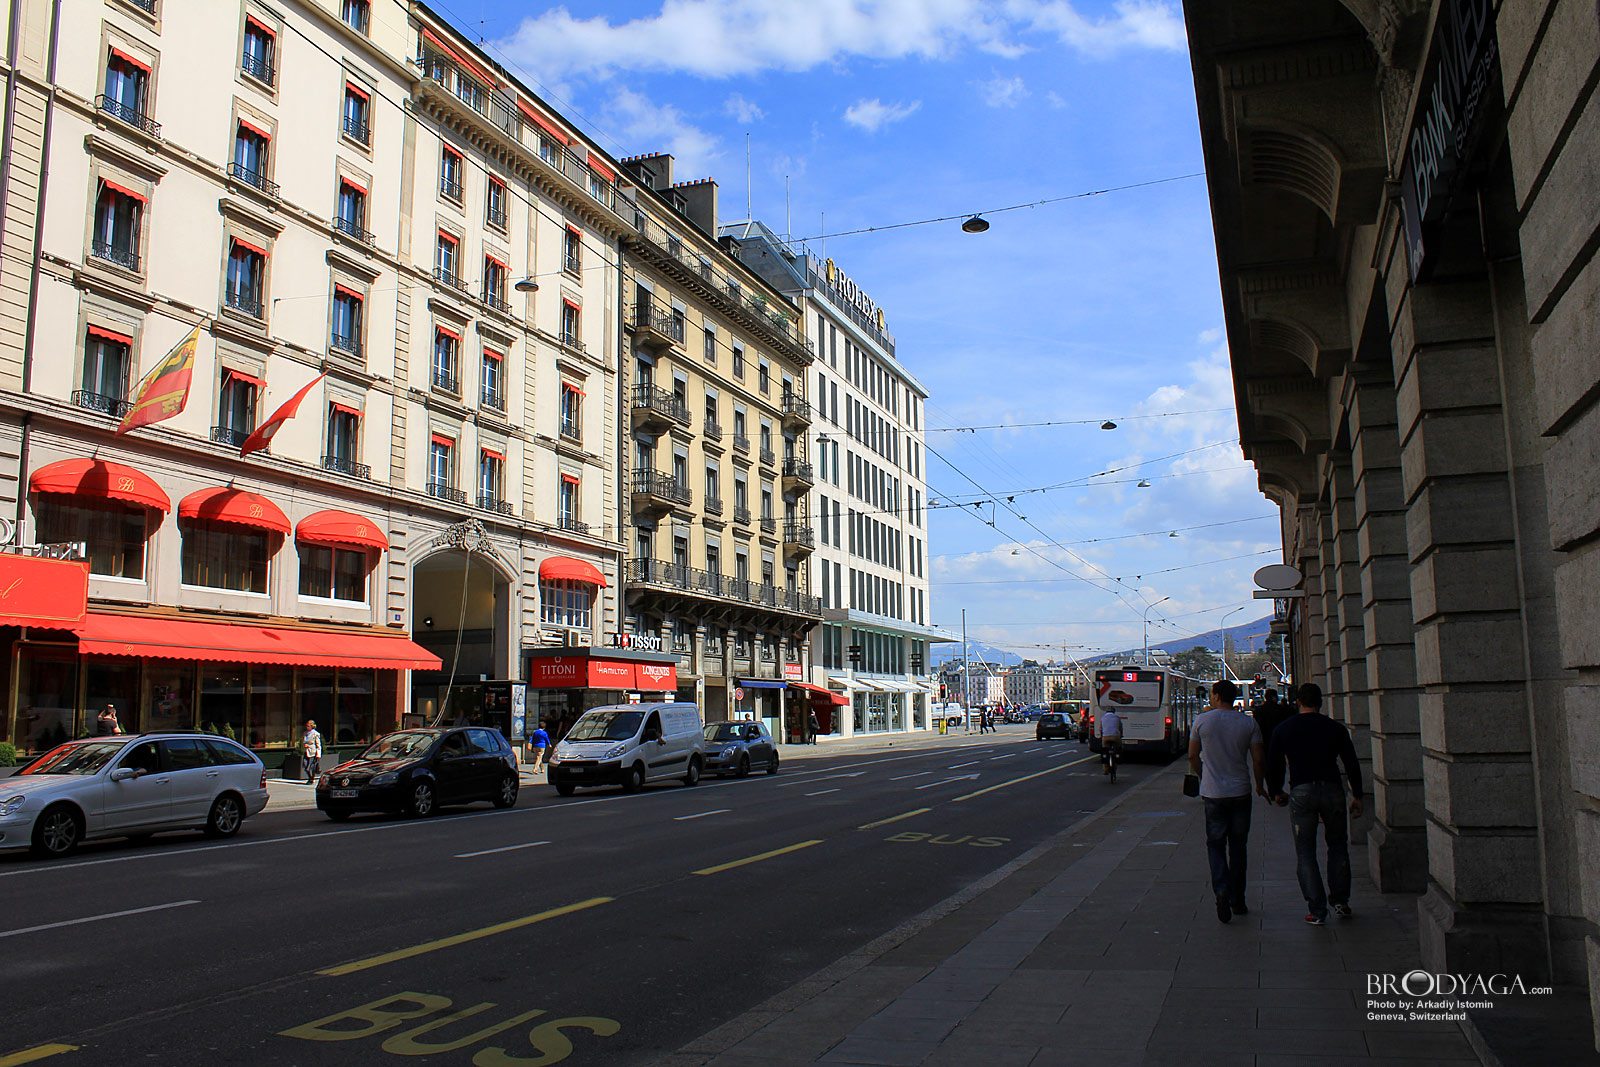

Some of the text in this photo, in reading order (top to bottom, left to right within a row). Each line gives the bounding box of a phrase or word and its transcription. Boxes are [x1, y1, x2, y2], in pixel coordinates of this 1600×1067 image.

[836, 266, 876, 325] ROLEX
[629, 634, 662, 650] TISSOT
[540, 664, 576, 675] TITONI
[641, 665, 671, 677] LONGINES
[1126, 672, 1133, 681] 9
[882, 831, 1012, 847] BUS
[276, 990, 622, 1067] BUS
